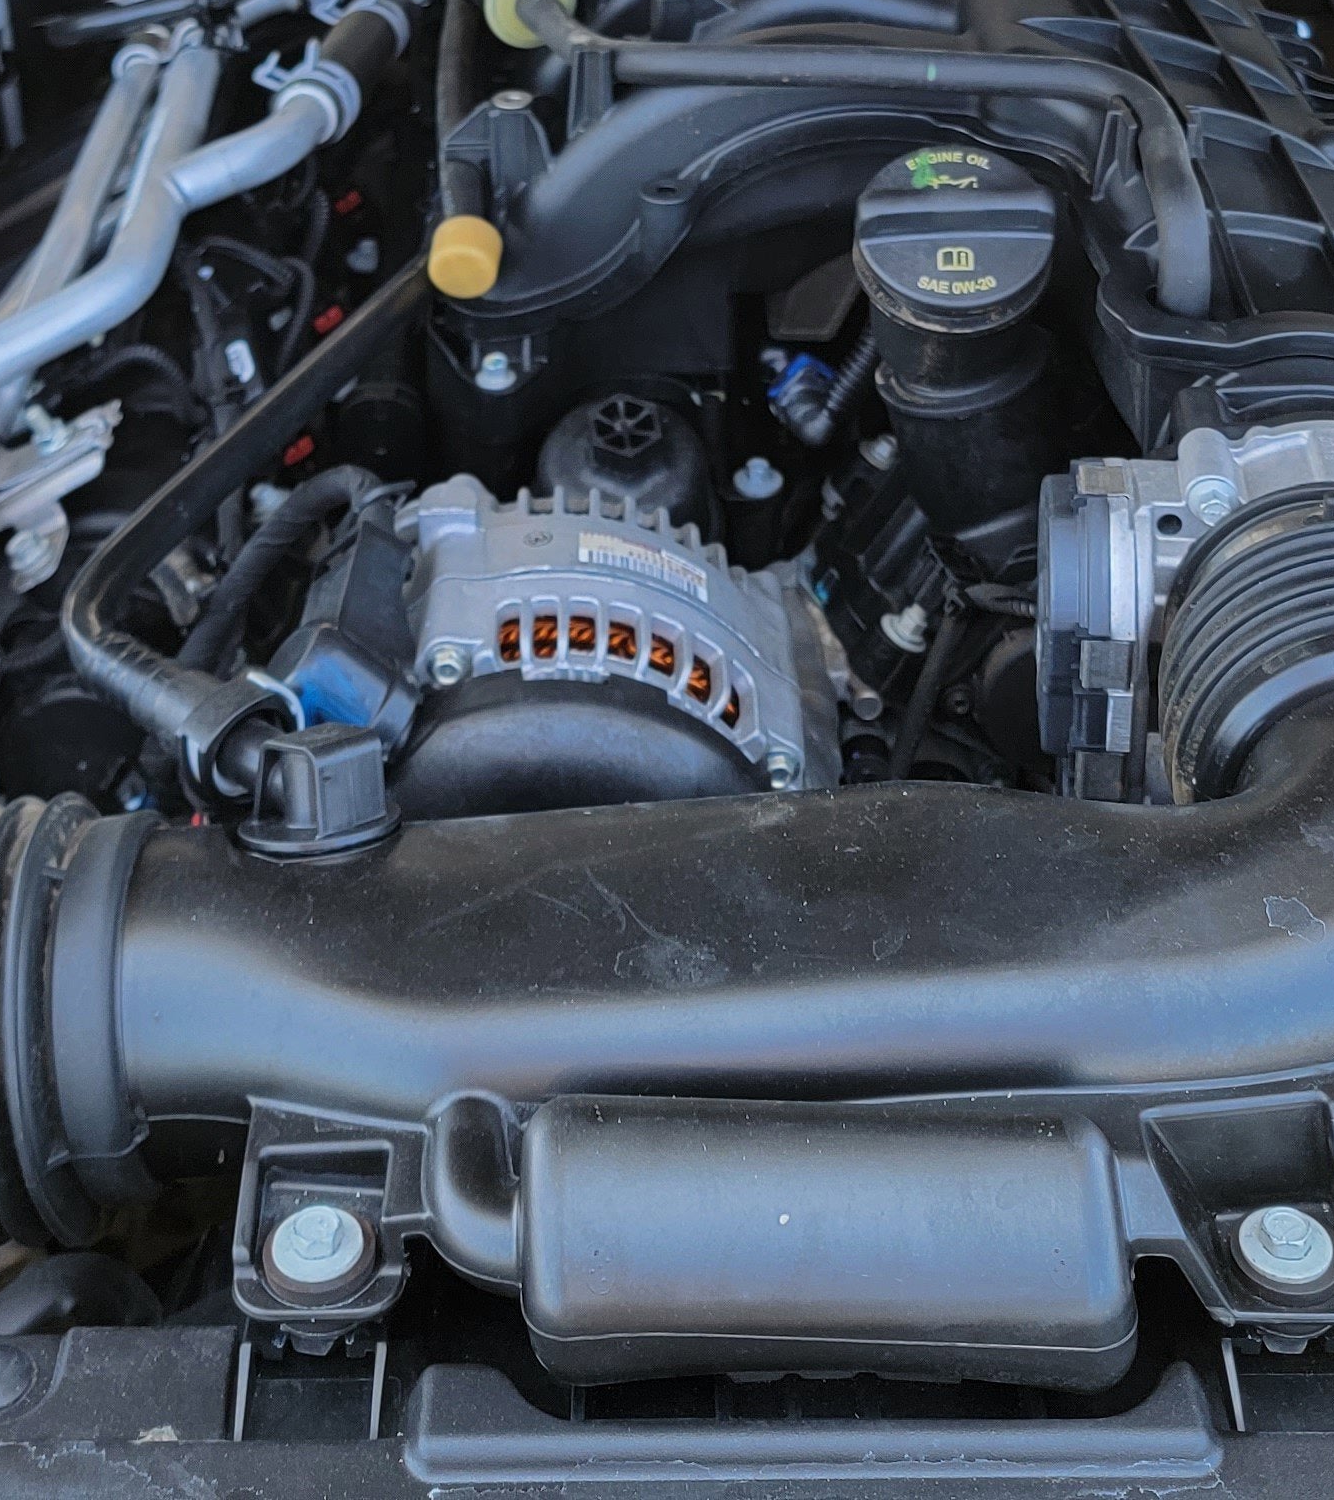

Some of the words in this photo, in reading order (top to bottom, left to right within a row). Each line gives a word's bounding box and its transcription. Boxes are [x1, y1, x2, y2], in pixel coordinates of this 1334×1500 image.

[966, 154, 991, 170] OIL
[917, 276, 950, 294] SAE
[952, 275, 997, 295] 0W-20
